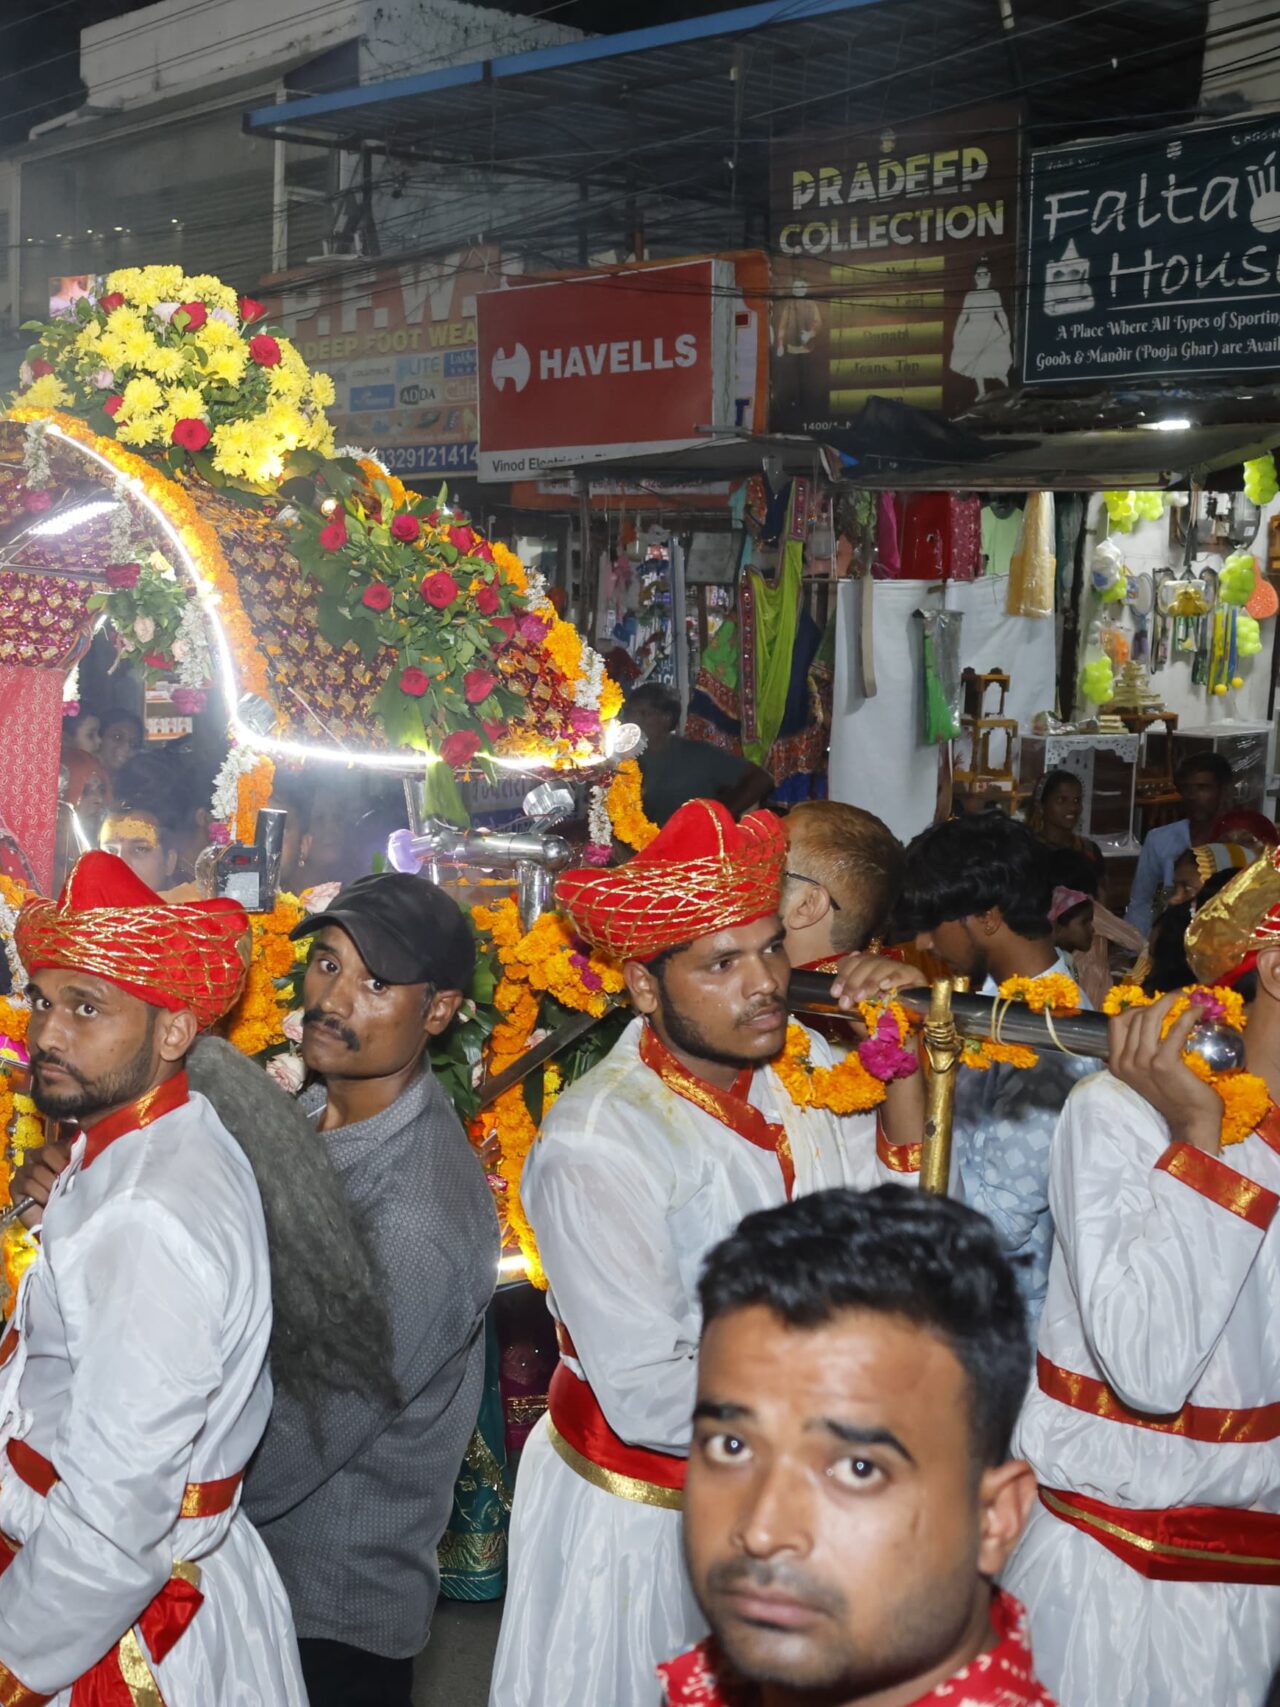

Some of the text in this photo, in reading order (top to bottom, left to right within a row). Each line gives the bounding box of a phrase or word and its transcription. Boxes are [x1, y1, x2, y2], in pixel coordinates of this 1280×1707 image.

[792, 147, 989, 210] PRADEEP
[779, 200, 1005, 254] COLLECTION
[1043, 173, 1239, 241] Falta
[1109, 245, 1280, 299] Hous
[303, 336, 360, 361] DEEP
[429, 321, 476, 348] WEA
[1056, 309, 1280, 341] A Place Where All Types of Sportin
[540, 334, 697, 380] HAVELLS
[1035, 336, 1280, 371] Goods & Mandir (Pooja Ghar) are Avail
[401, 386, 436, 404] ADDA
[492, 458, 525, 473] Vinod
